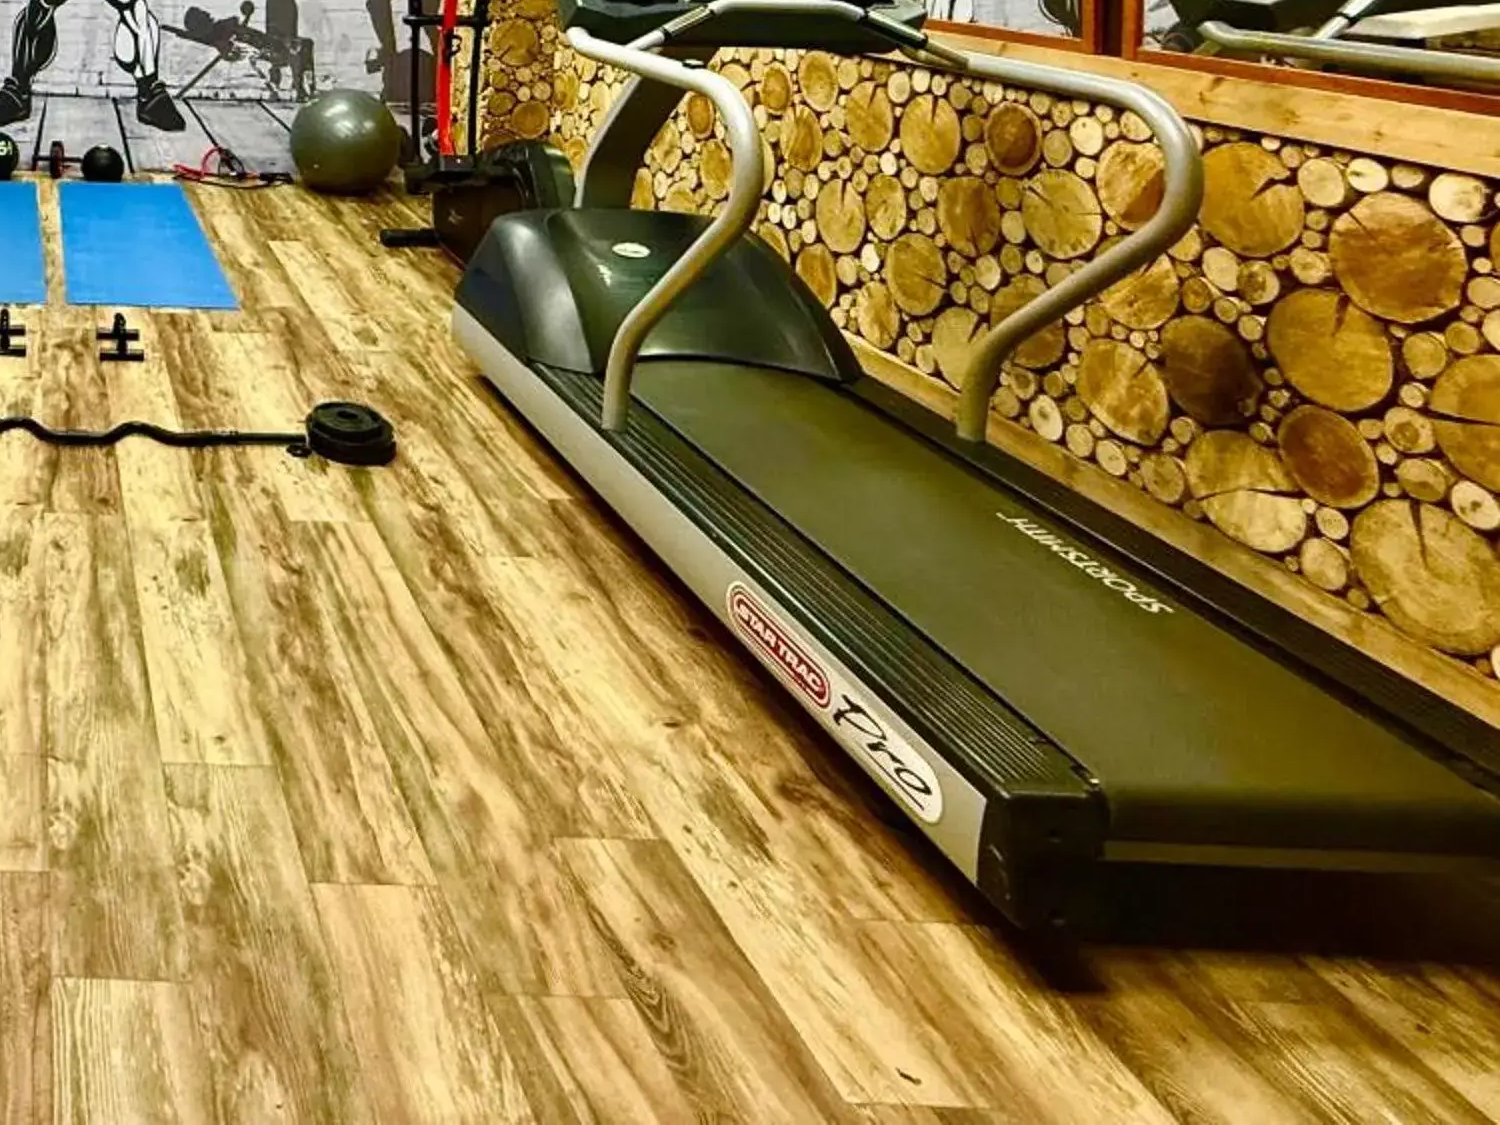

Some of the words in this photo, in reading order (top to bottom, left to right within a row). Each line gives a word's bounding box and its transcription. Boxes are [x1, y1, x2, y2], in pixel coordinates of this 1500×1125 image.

[736, 601, 777, 649] STAR
[777, 641, 825, 691] TRAC
[832, 693, 933, 797] Pro
